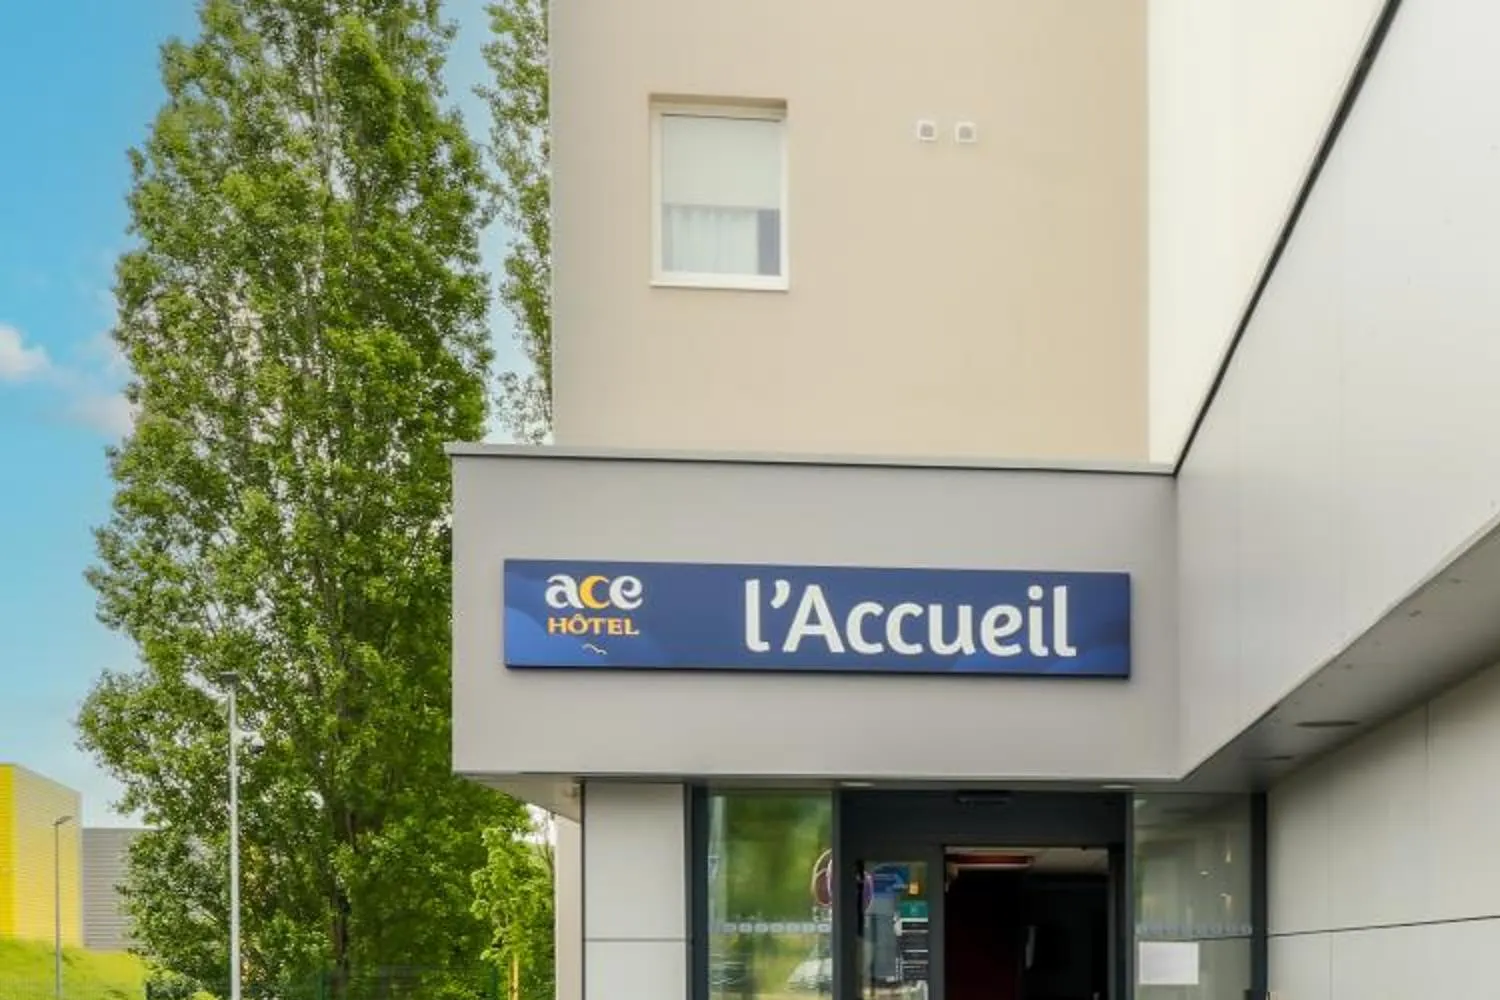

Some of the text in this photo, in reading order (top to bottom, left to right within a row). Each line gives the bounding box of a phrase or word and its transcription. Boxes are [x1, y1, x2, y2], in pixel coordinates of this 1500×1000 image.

[545, 574, 643, 610] ace
[547, 613, 640, 635] HÔTEL
[744, 578, 1078, 657] l’Accueil
